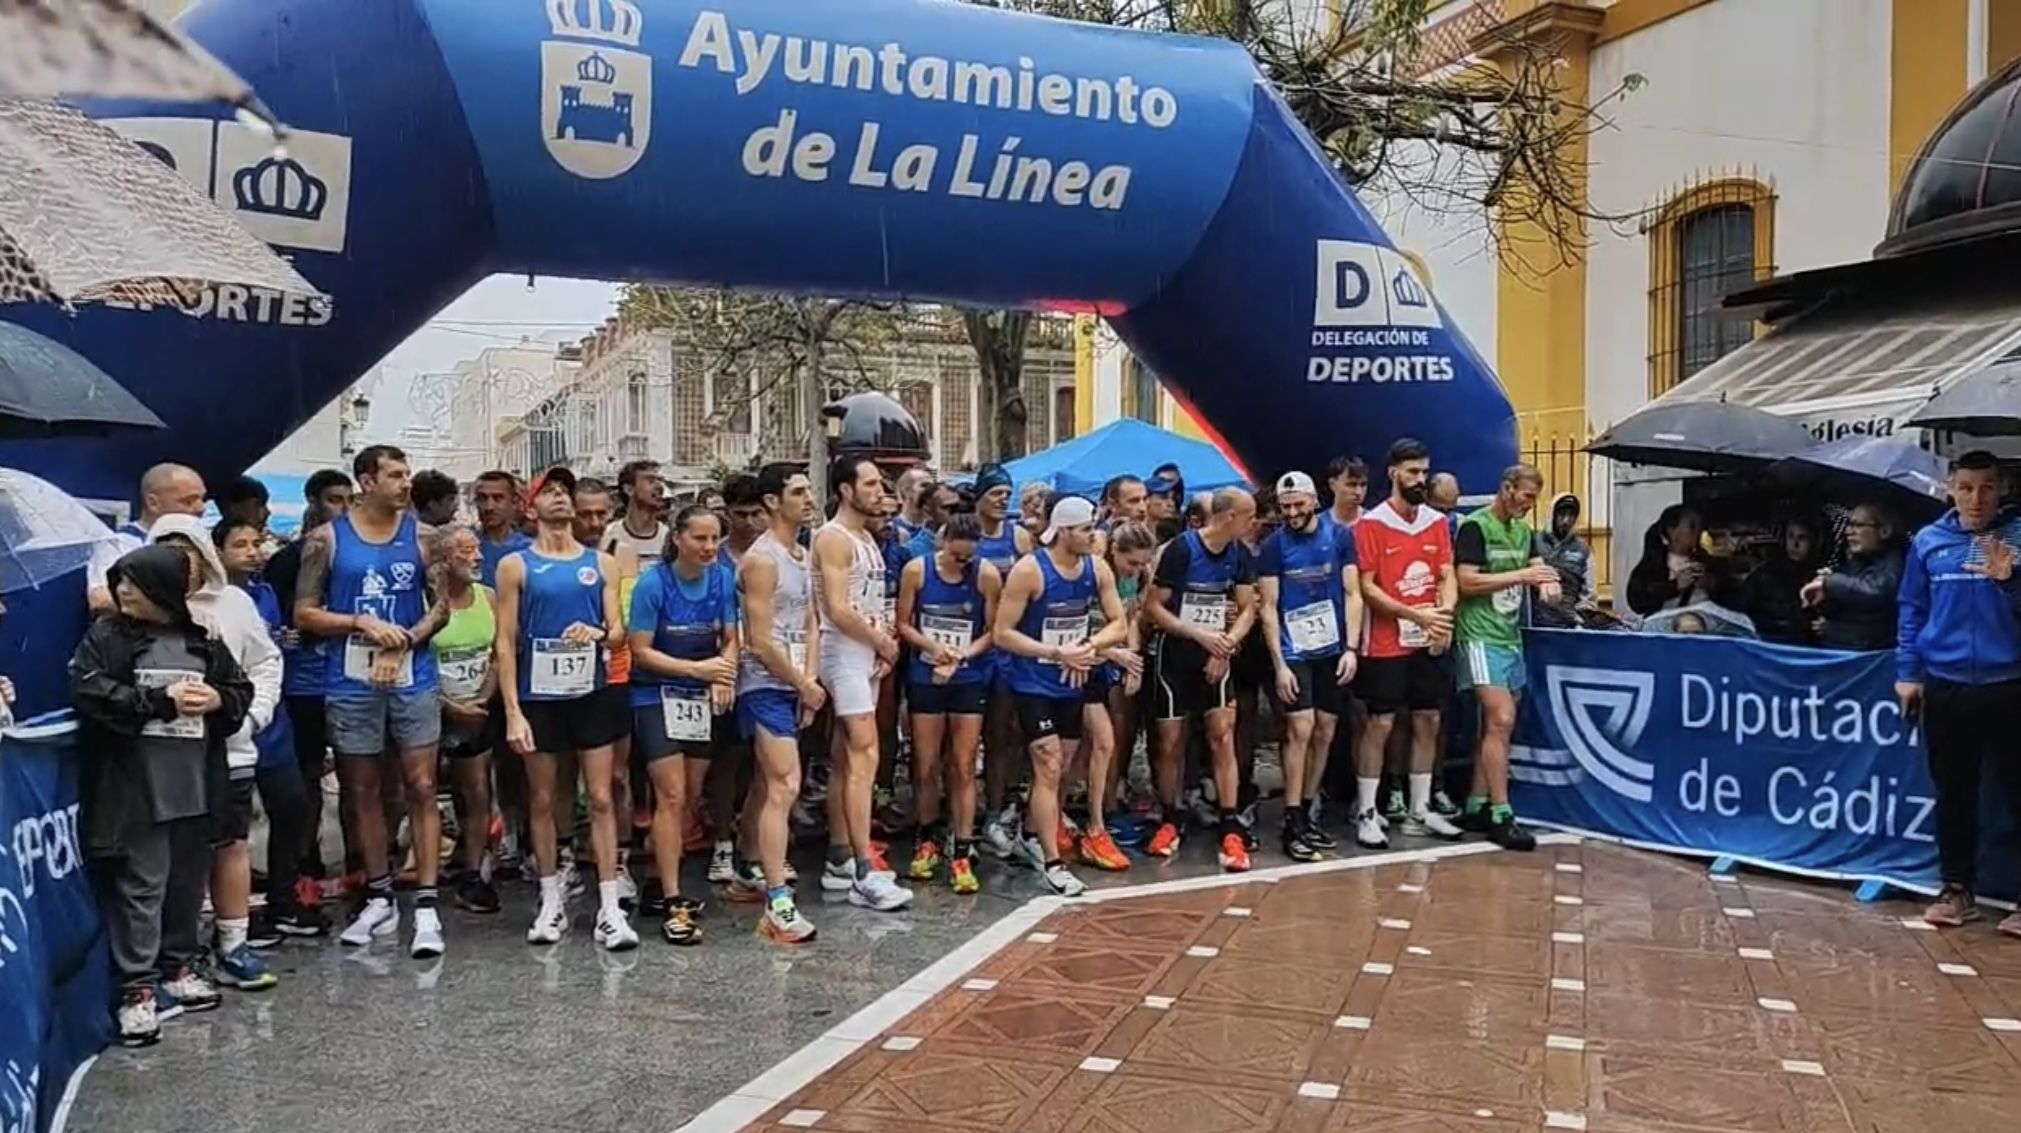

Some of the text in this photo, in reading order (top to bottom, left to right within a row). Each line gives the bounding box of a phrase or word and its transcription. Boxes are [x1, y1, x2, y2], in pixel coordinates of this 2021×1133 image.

[679, 13, 1177, 127] Ayuntamiento
[742, 109, 1132, 210] de La Línea
[1335, 261, 1370, 309] D
[1312, 329, 1429, 346] DELEGACIÓN DE
[1307, 356, 1454, 382] DEPORTES
[1802, 415, 1893, 443] glesia
[1193, 608, 1221, 624] 225
[1306, 616, 1326, 635] 23
[552, 656, 587, 676] 137
[676, 702, 702, 722] 243
[1679, 755, 1937, 843] de Cádiz
